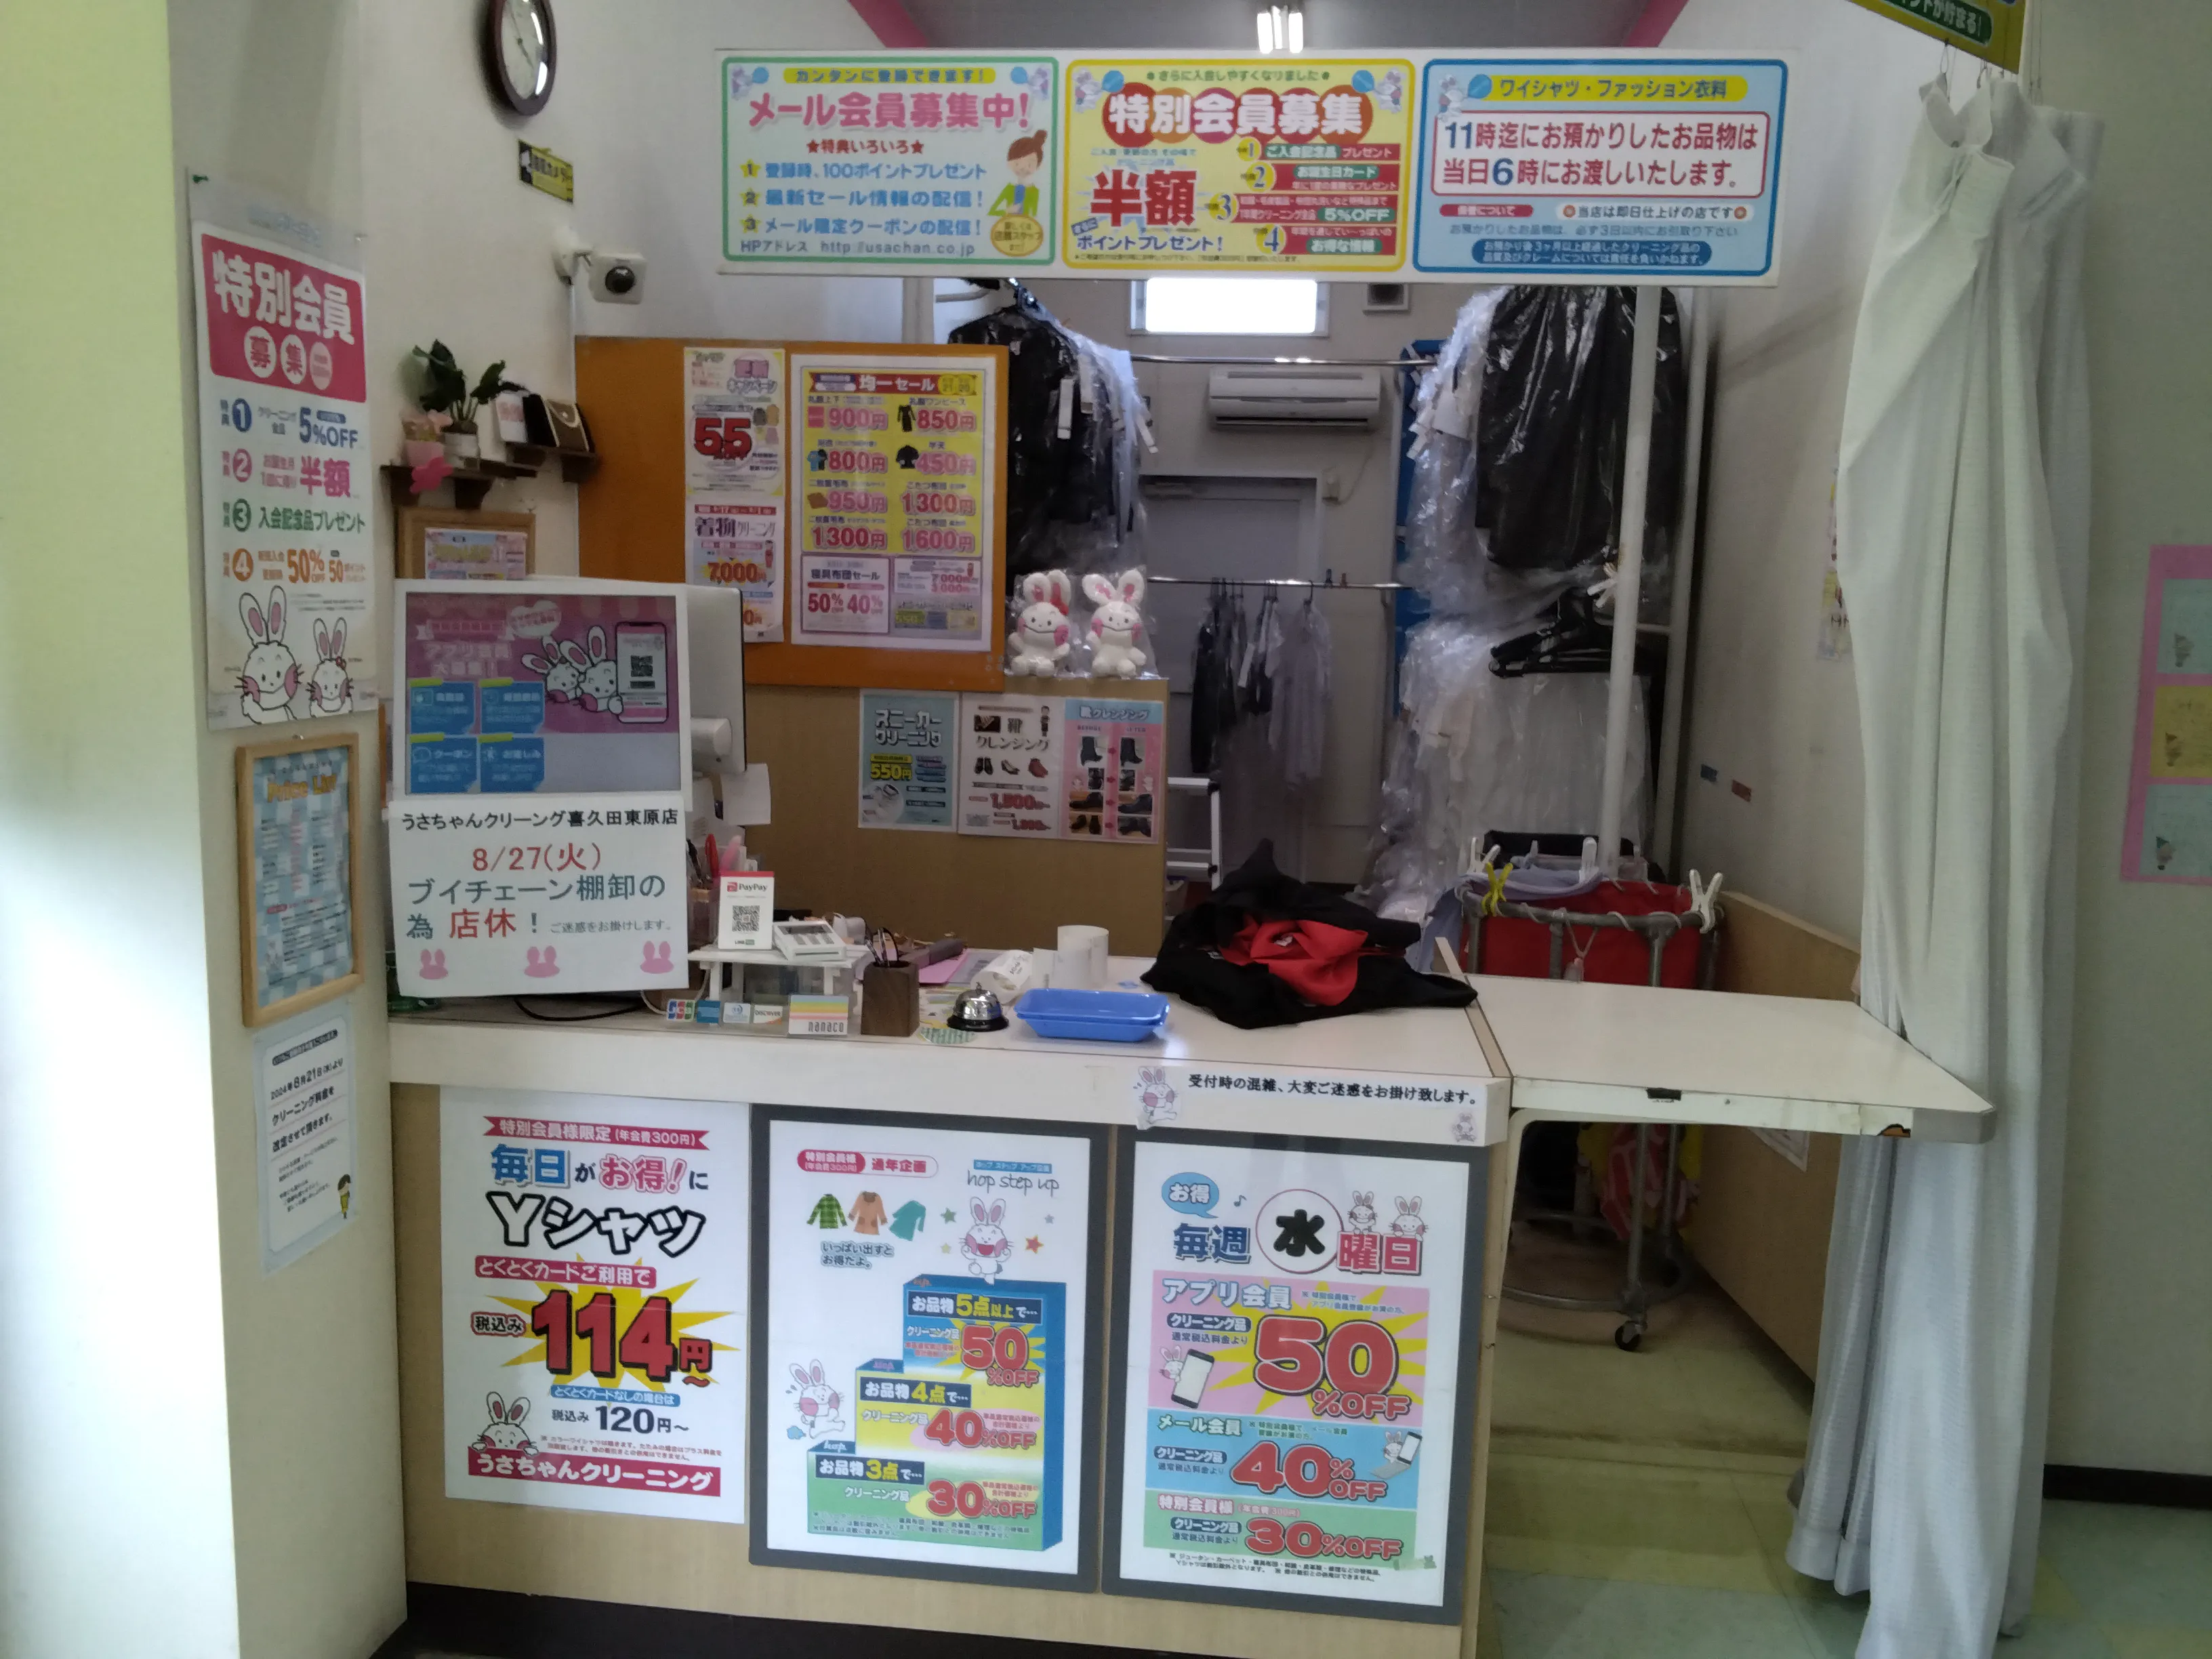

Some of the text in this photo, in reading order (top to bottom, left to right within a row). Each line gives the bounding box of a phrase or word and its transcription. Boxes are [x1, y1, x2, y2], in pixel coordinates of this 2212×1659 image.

[749, 92, 1029, 128] メール会員募集中!
[1109, 92, 1362, 135] 特別会員募集
[1444, 121, 1758, 150] 11時迄にお預かりしたお品物は
[1254, 166, 1266, 188] 2
[1443, 157, 1737, 188] 当日6時にお渡しいたします。
[1090, 169, 1197, 227] 半額
[1217, 194, 1231, 221] 3
[1076, 236, 1223, 252] ポイントプレゼント!
[1263, 226, 1280, 252] 4
[212, 250, 354, 344] 特別会員
[917, 409, 976, 432] 850円
[828, 449, 888, 473] 800円
[300, 455, 351, 497] 半額
[402, 807, 678, 832] うさちゃんクリーニング喜久田東原店
[407, 873, 665, 905] ブイチェーン棚卸の
[739, 882, 768, 893] PayPay
[808, 1021, 845, 1033] nanaco
[1189, 1073, 1477, 1106] 受付時の混雑、大変ご迷惑をお掛け致します。
[499, 1119, 611, 1143] 特別会員様限定
[967, 1170, 995, 1193] hop
[999, 1172, 1033, 1195] step
[1168, 1182, 1210, 1205] お得
[485, 1190, 707, 1258] Yシャツ
[1173, 1223, 1251, 1265] 毎週
[1337, 1231, 1422, 1275] 曜日
[478, 1258, 651, 1286] とくとくカードご利用で
[1162, 1277, 1293, 1311] アプリ会員
[475, 1316, 524, 1334] 税込み
[1170, 1314, 1248, 1331] クリーニング品
[961, 1323, 1029, 1372] 50
[1253, 1313, 1399, 1397] 50
[552, 1409, 590, 1423] 税込み
[1158, 1413, 1243, 1437] メール会員
[1156, 1447, 1224, 1464] クリーニング品
[476, 1453, 715, 1491] うさちゃんクリーニング
[1158, 1494, 1235, 1515] 特別会員様
[1174, 1518, 1240, 1534] クリーニング品
